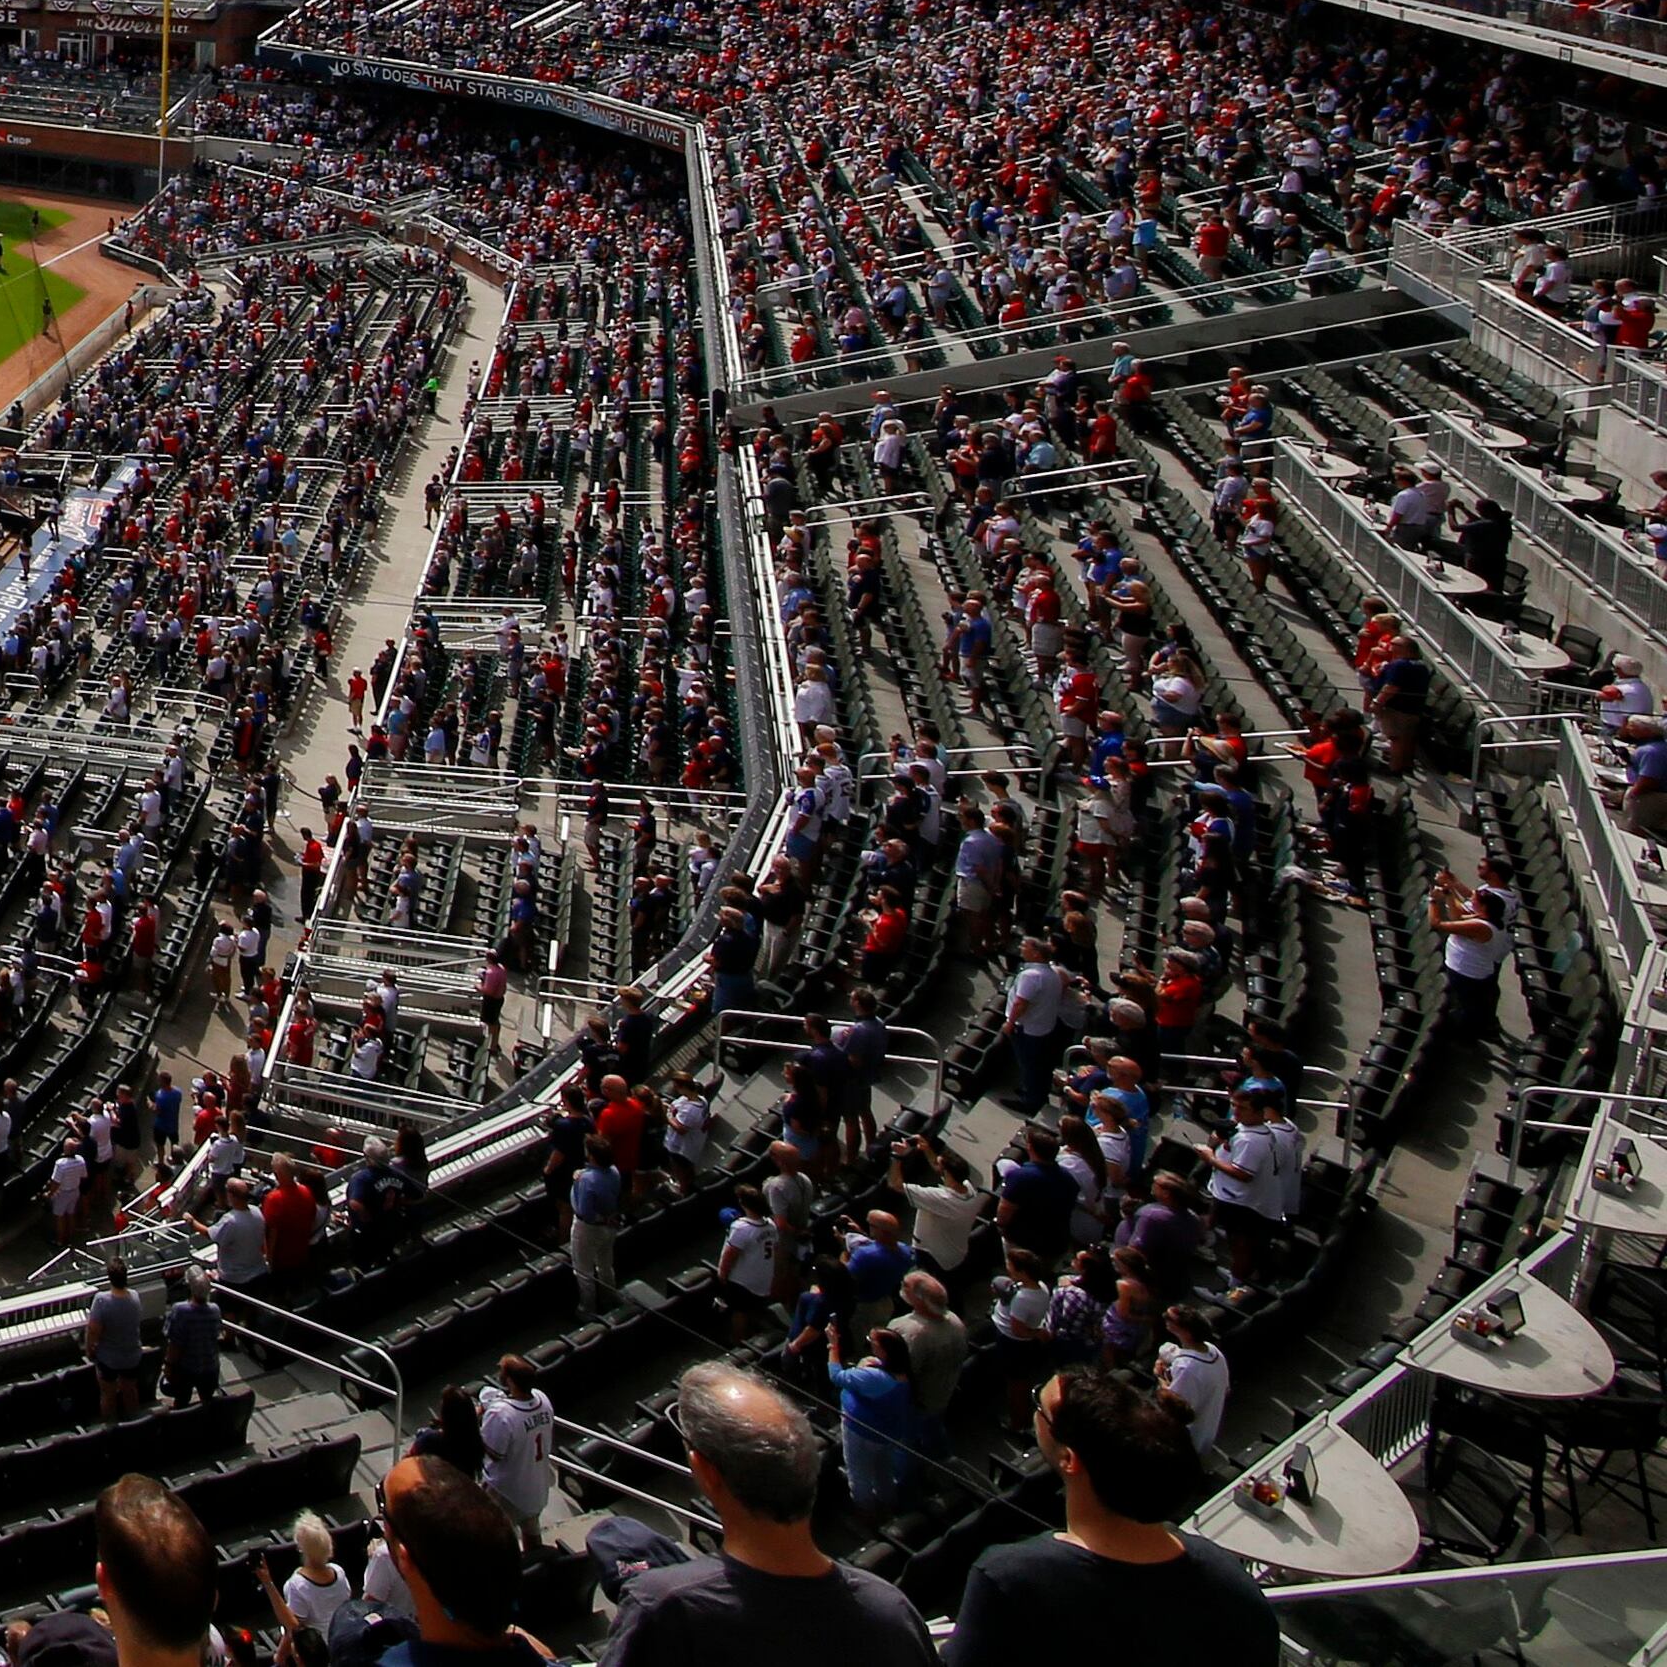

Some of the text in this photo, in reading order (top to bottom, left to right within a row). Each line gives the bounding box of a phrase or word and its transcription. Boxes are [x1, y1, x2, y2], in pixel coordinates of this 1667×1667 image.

[76, 17, 93, 27] THE
[94, 14, 155, 34] Silver
[353, 63, 379, 79] SAY
[381, 68, 420, 86] DOES
[421, 75, 461, 93] THAT
[466, 82, 579, 117] STAR-SPANGLED
[580, 102, 624, 128] BANNER
[624, 115, 645, 135] YET
[646, 121, 680, 147] WAVE
[6, 134, 31, 146] CHOP
[535, 1432, 542, 1463] 1
